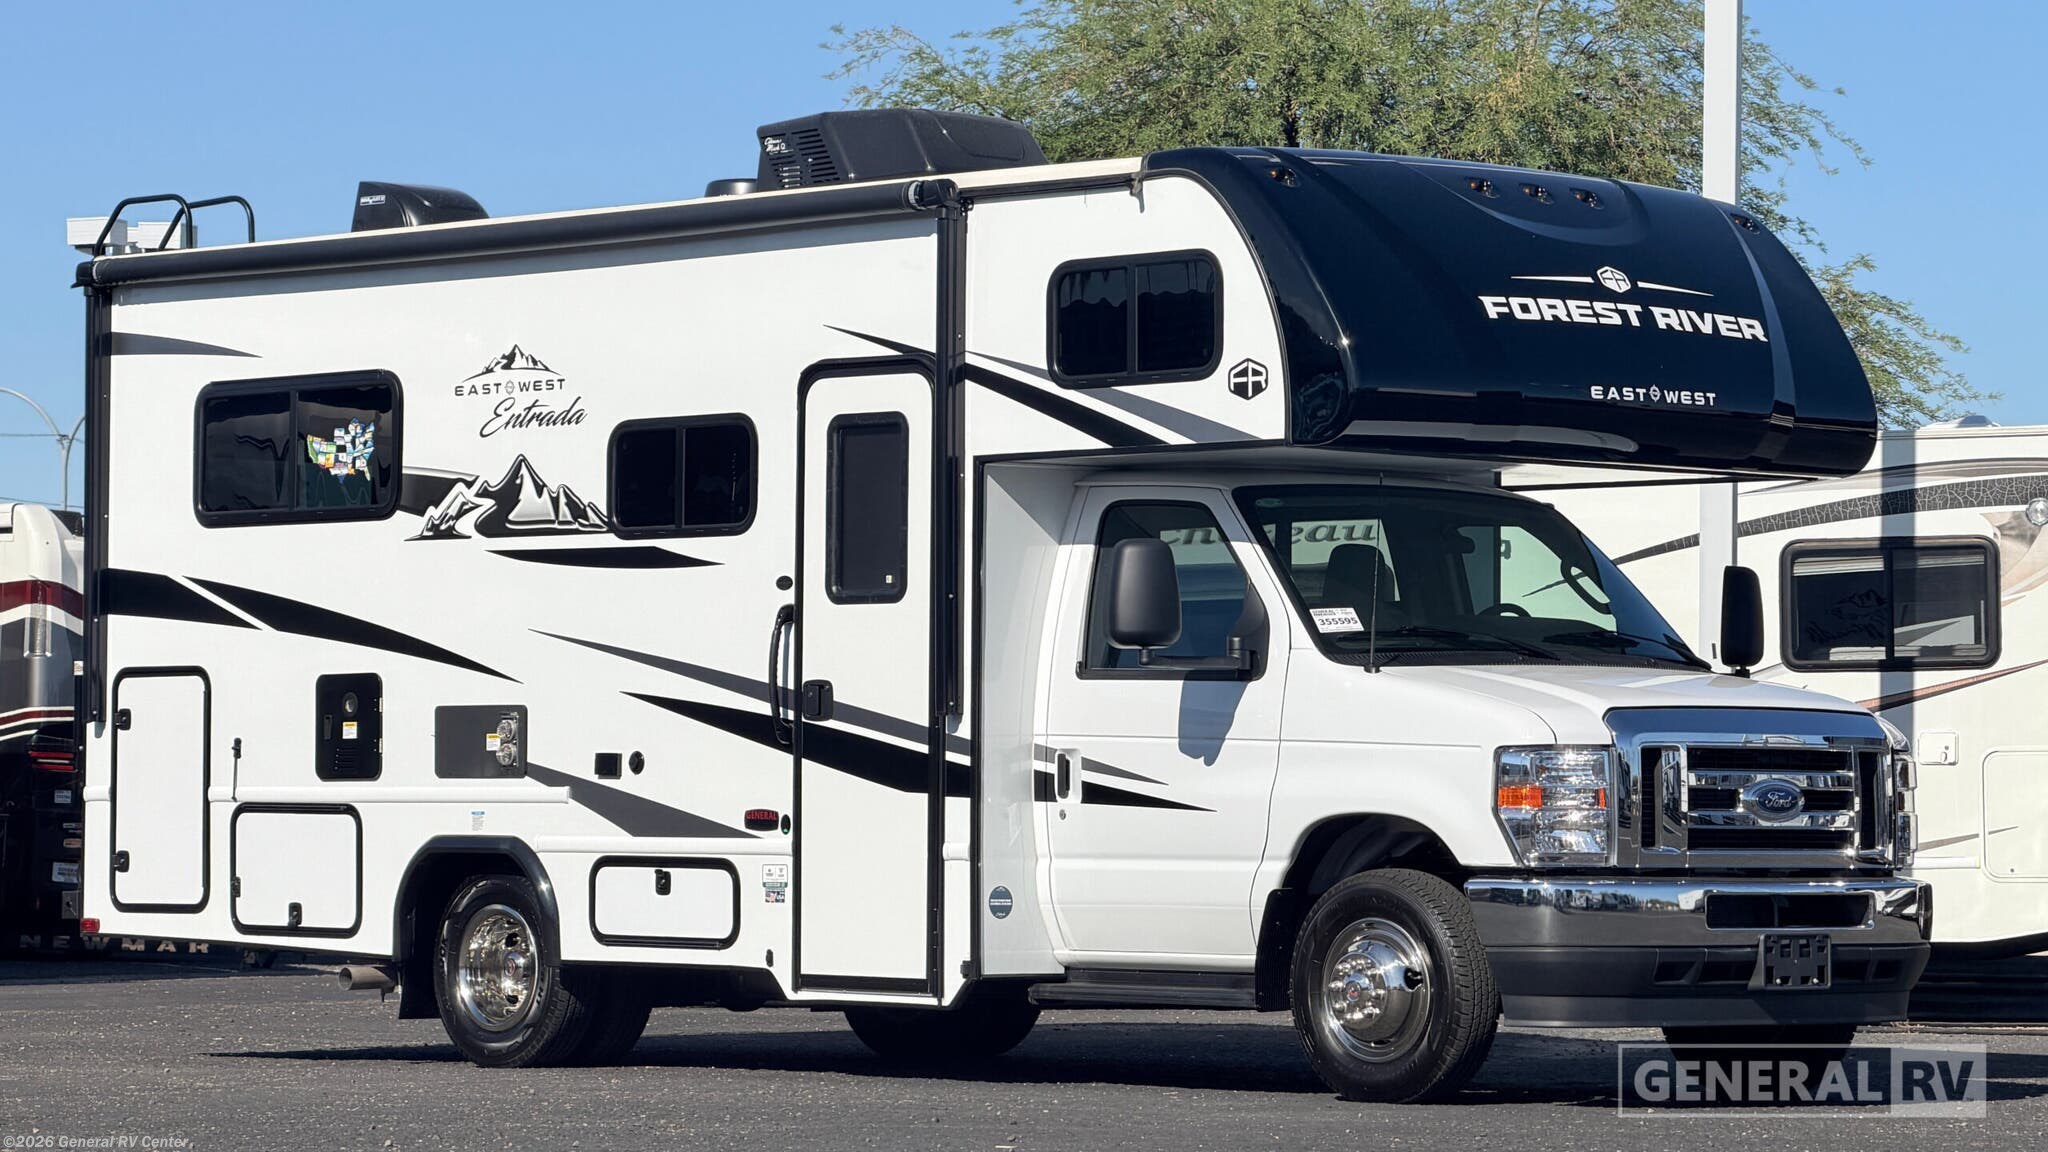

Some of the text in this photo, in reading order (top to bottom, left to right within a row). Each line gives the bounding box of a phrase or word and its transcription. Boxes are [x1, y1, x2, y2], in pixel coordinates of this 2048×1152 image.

[1478, 296, 1768, 342] FOREST RIVER
[454, 379, 565, 396] EAST WEST
[1590, 385, 1716, 406] EAST WEST
[479, 396, 588, 438] Entrada
[1318, 617, 1358, 626] 355595
[1765, 791, 1794, 808] Ford
[746, 810, 777, 820] GENERAL
